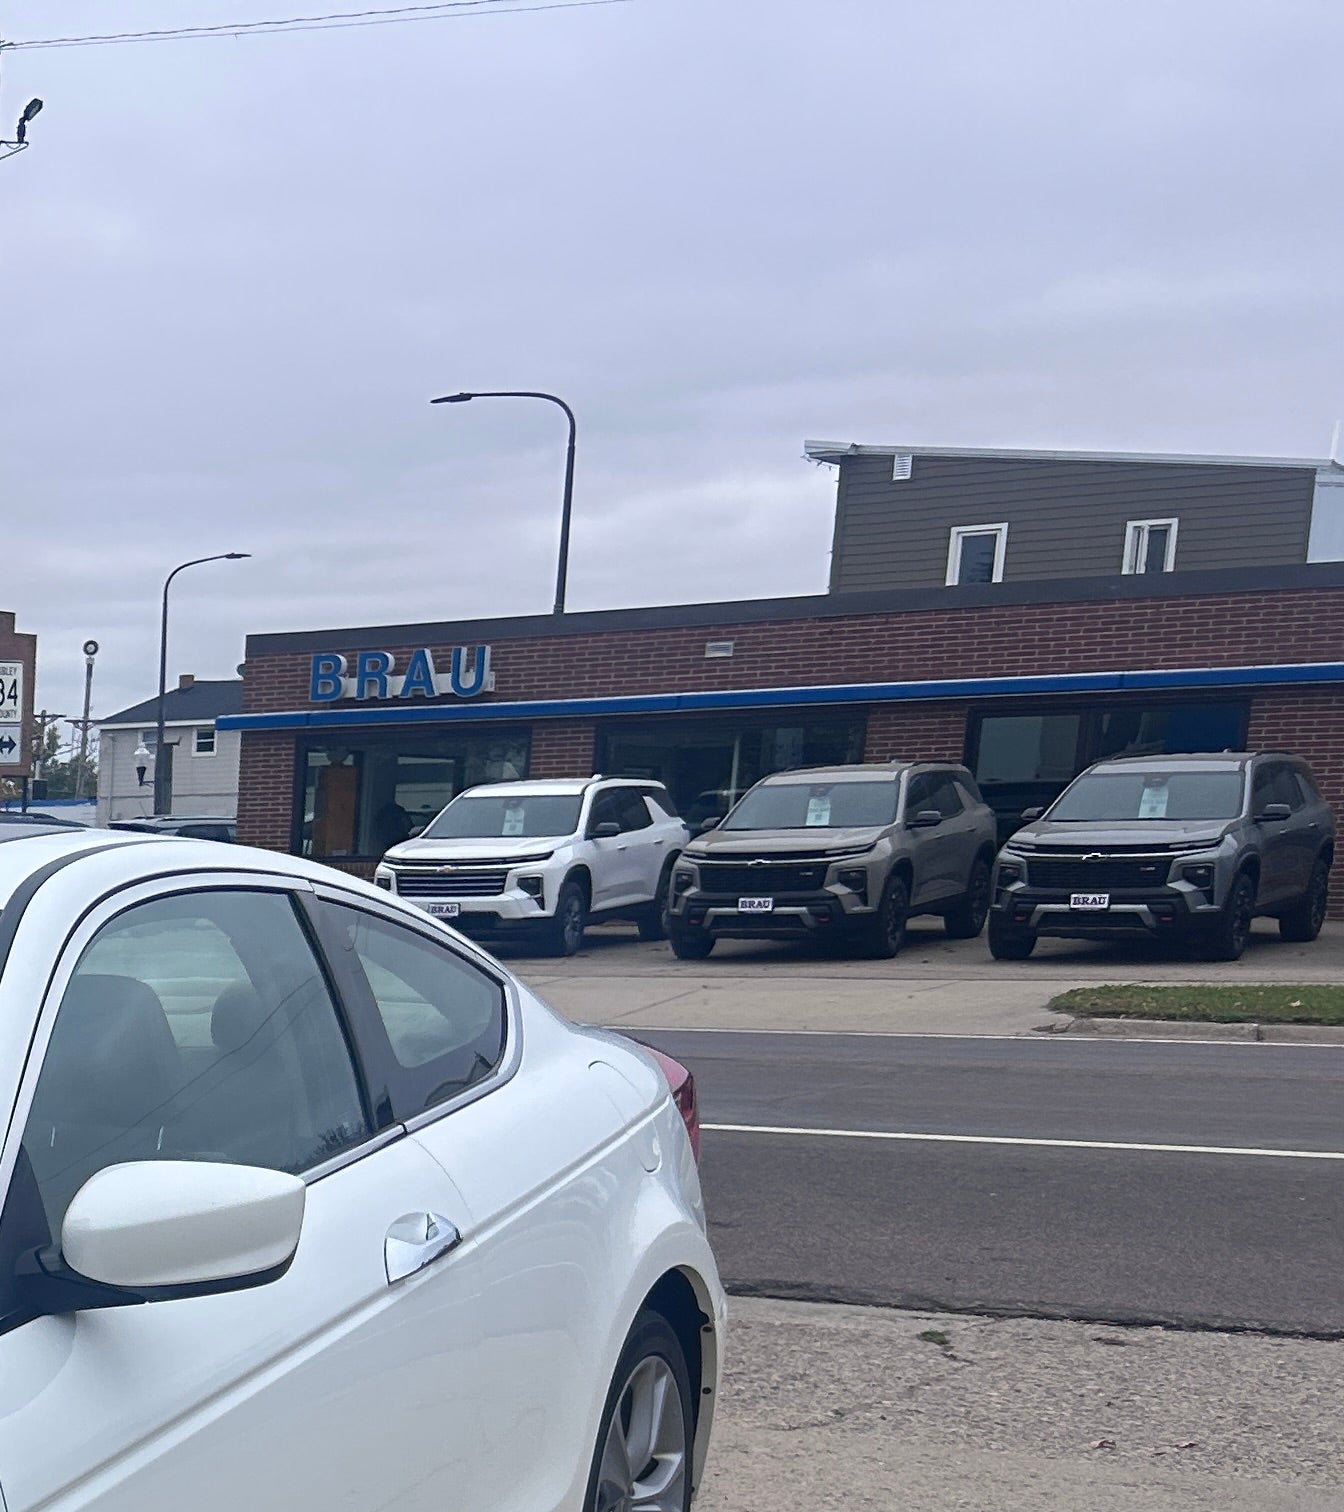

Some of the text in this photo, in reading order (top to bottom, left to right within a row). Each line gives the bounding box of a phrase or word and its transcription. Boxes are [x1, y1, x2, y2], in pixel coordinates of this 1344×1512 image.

[309, 645, 491, 702] BRAU
[740, 900, 770, 909] BRAU
[1072, 896, 1107, 905] BRAU
